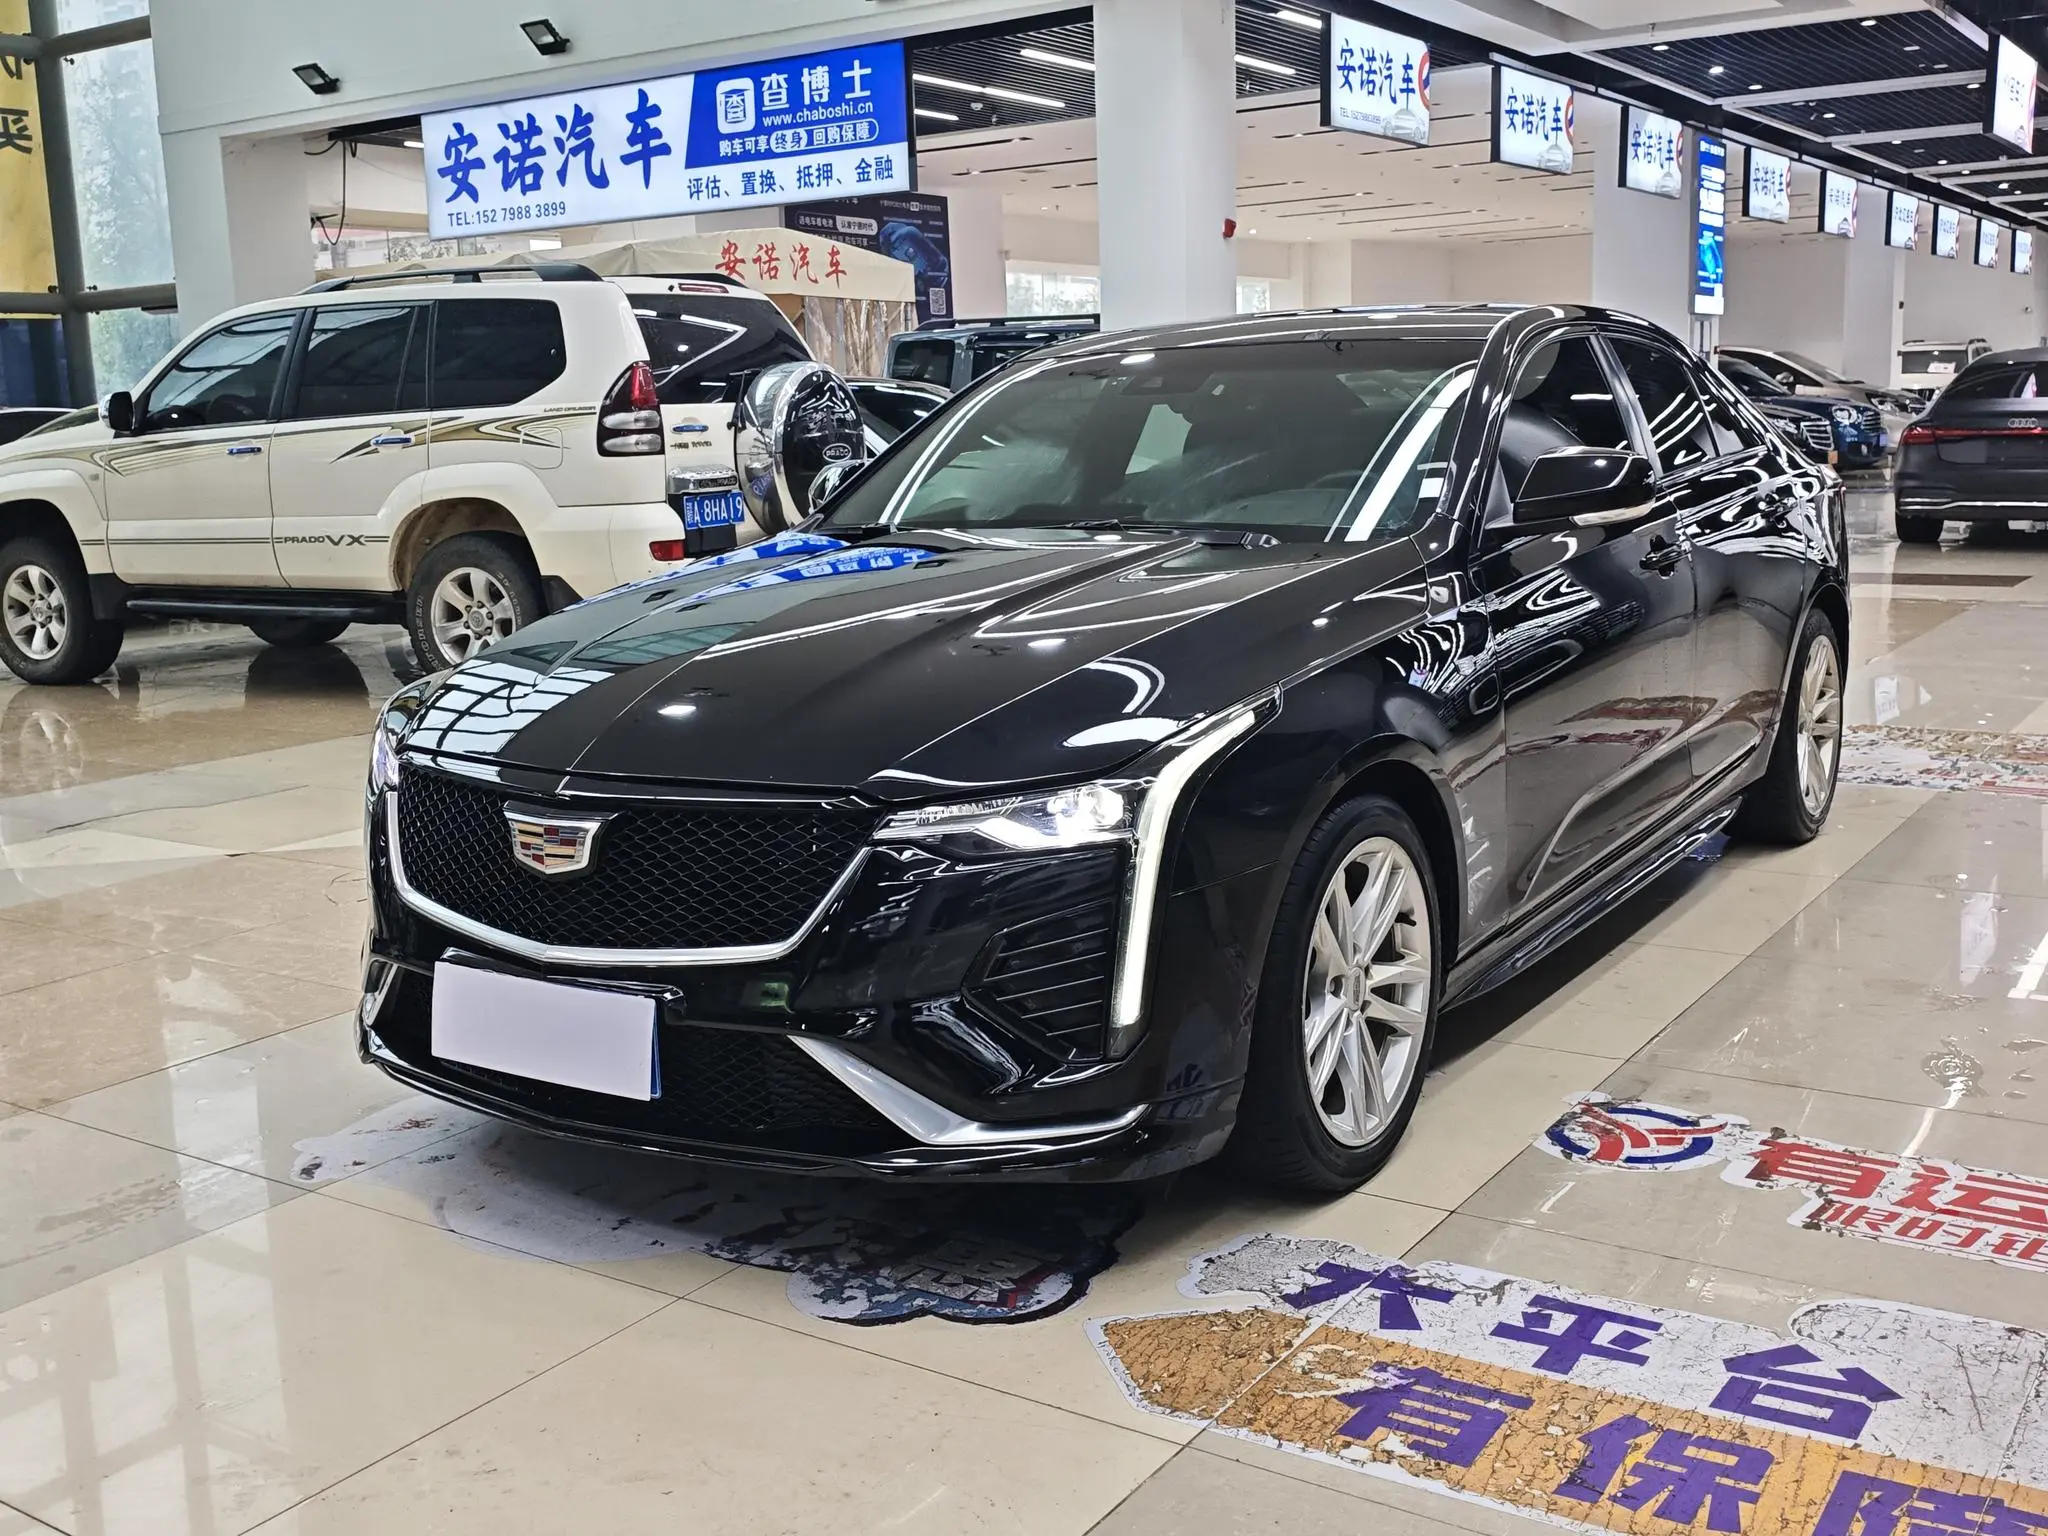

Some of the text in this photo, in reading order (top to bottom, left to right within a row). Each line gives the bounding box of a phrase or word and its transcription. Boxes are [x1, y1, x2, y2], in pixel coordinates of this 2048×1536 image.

[760, 58, 872, 111] 查博士
[1336, 38, 1416, 110] 安诺汽车
[762, 101, 873, 127] www.chaboshi.cn
[1505, 87, 1563, 145] 安诺汽车
[437, 88, 672, 204] 安诺汽车
[1631, 123, 1674, 173] 安诺汽车
[448, 201, 566, 227] TEL:152 7988 3899
[715, 239, 847, 289] 安诺汽车
[284, 534, 366, 546] PRADO VX
[1281, 1261, 1904, 1441] 大平台
